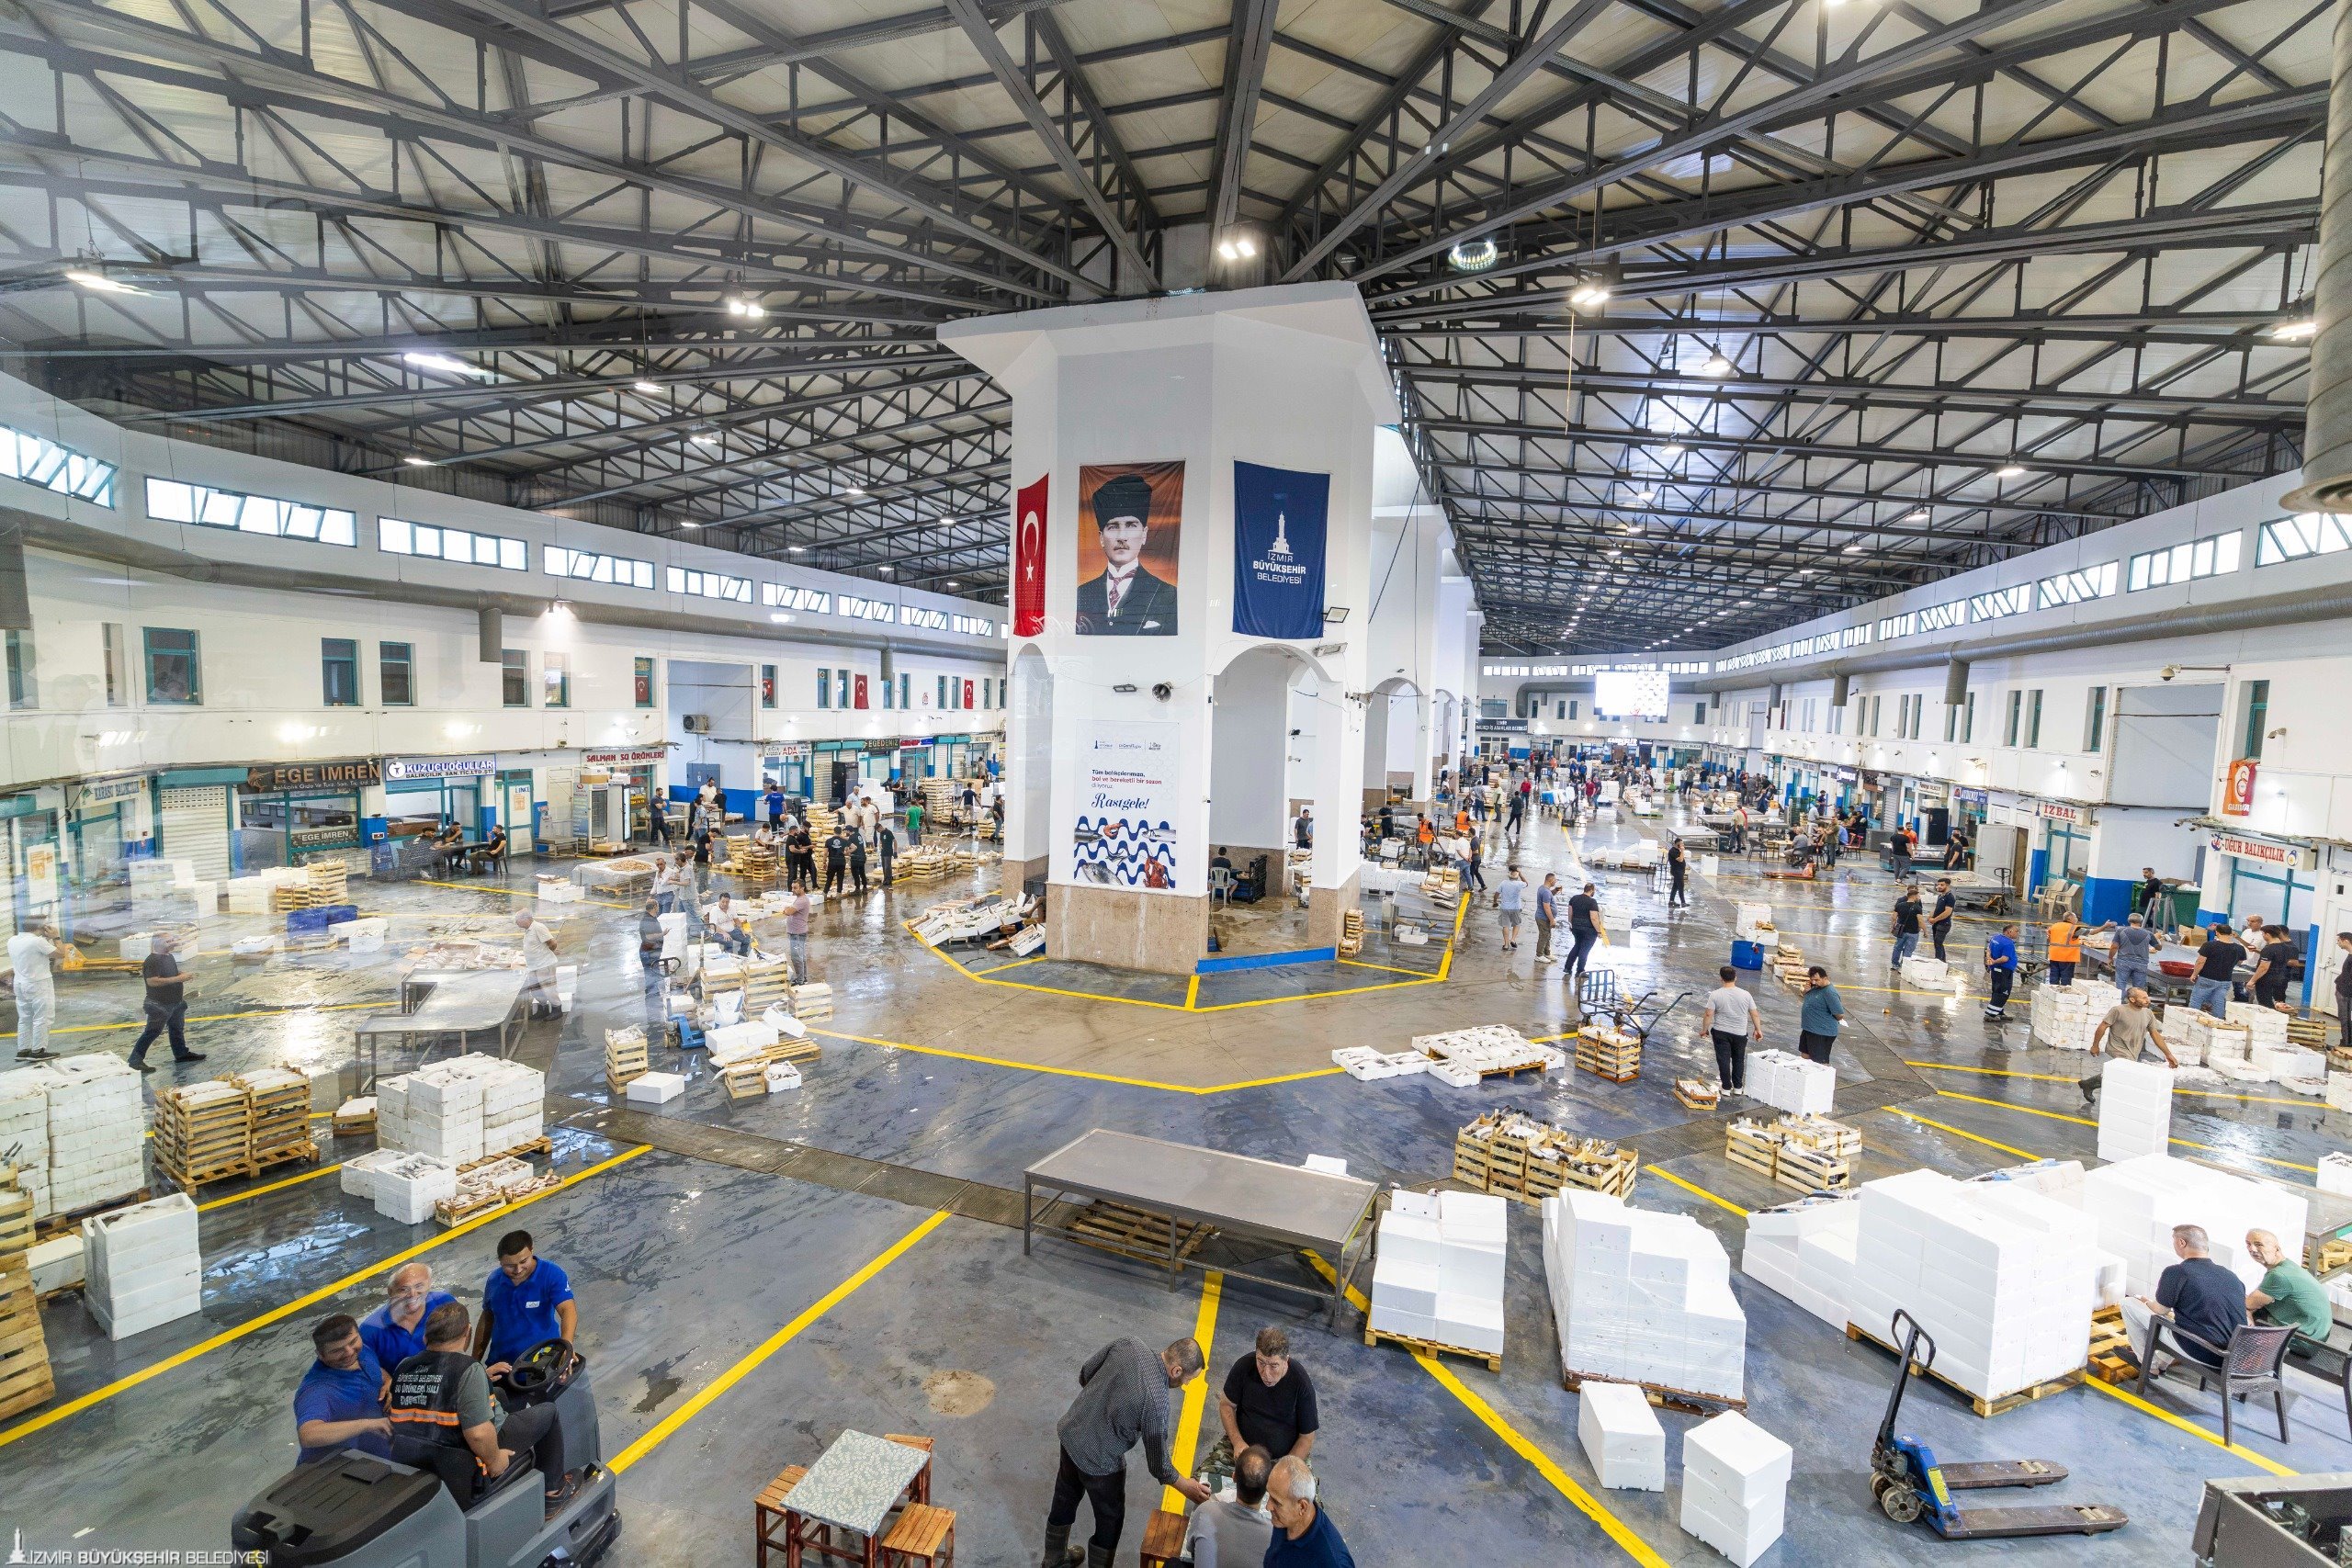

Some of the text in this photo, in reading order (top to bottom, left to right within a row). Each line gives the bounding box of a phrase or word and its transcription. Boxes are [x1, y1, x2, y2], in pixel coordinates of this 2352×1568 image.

[1268, 553, 1293, 562] İZMİR
[1257, 573, 1302, 584] BELEDİYESİ
[782, 746, 798, 755] ADA
[587, 755, 616, 763] SALMAN
[405, 760, 496, 773] KUZUCUOĞULLARI
[274, 764, 380, 784] EGE İMREN
[1091, 792, 1150, 811] Rastgele!
[2044, 802, 2076, 819] İZBAL
[322, 830, 349, 839] İMREN
[2225, 837, 2285, 863] UĞUR BALIKÇILIK
